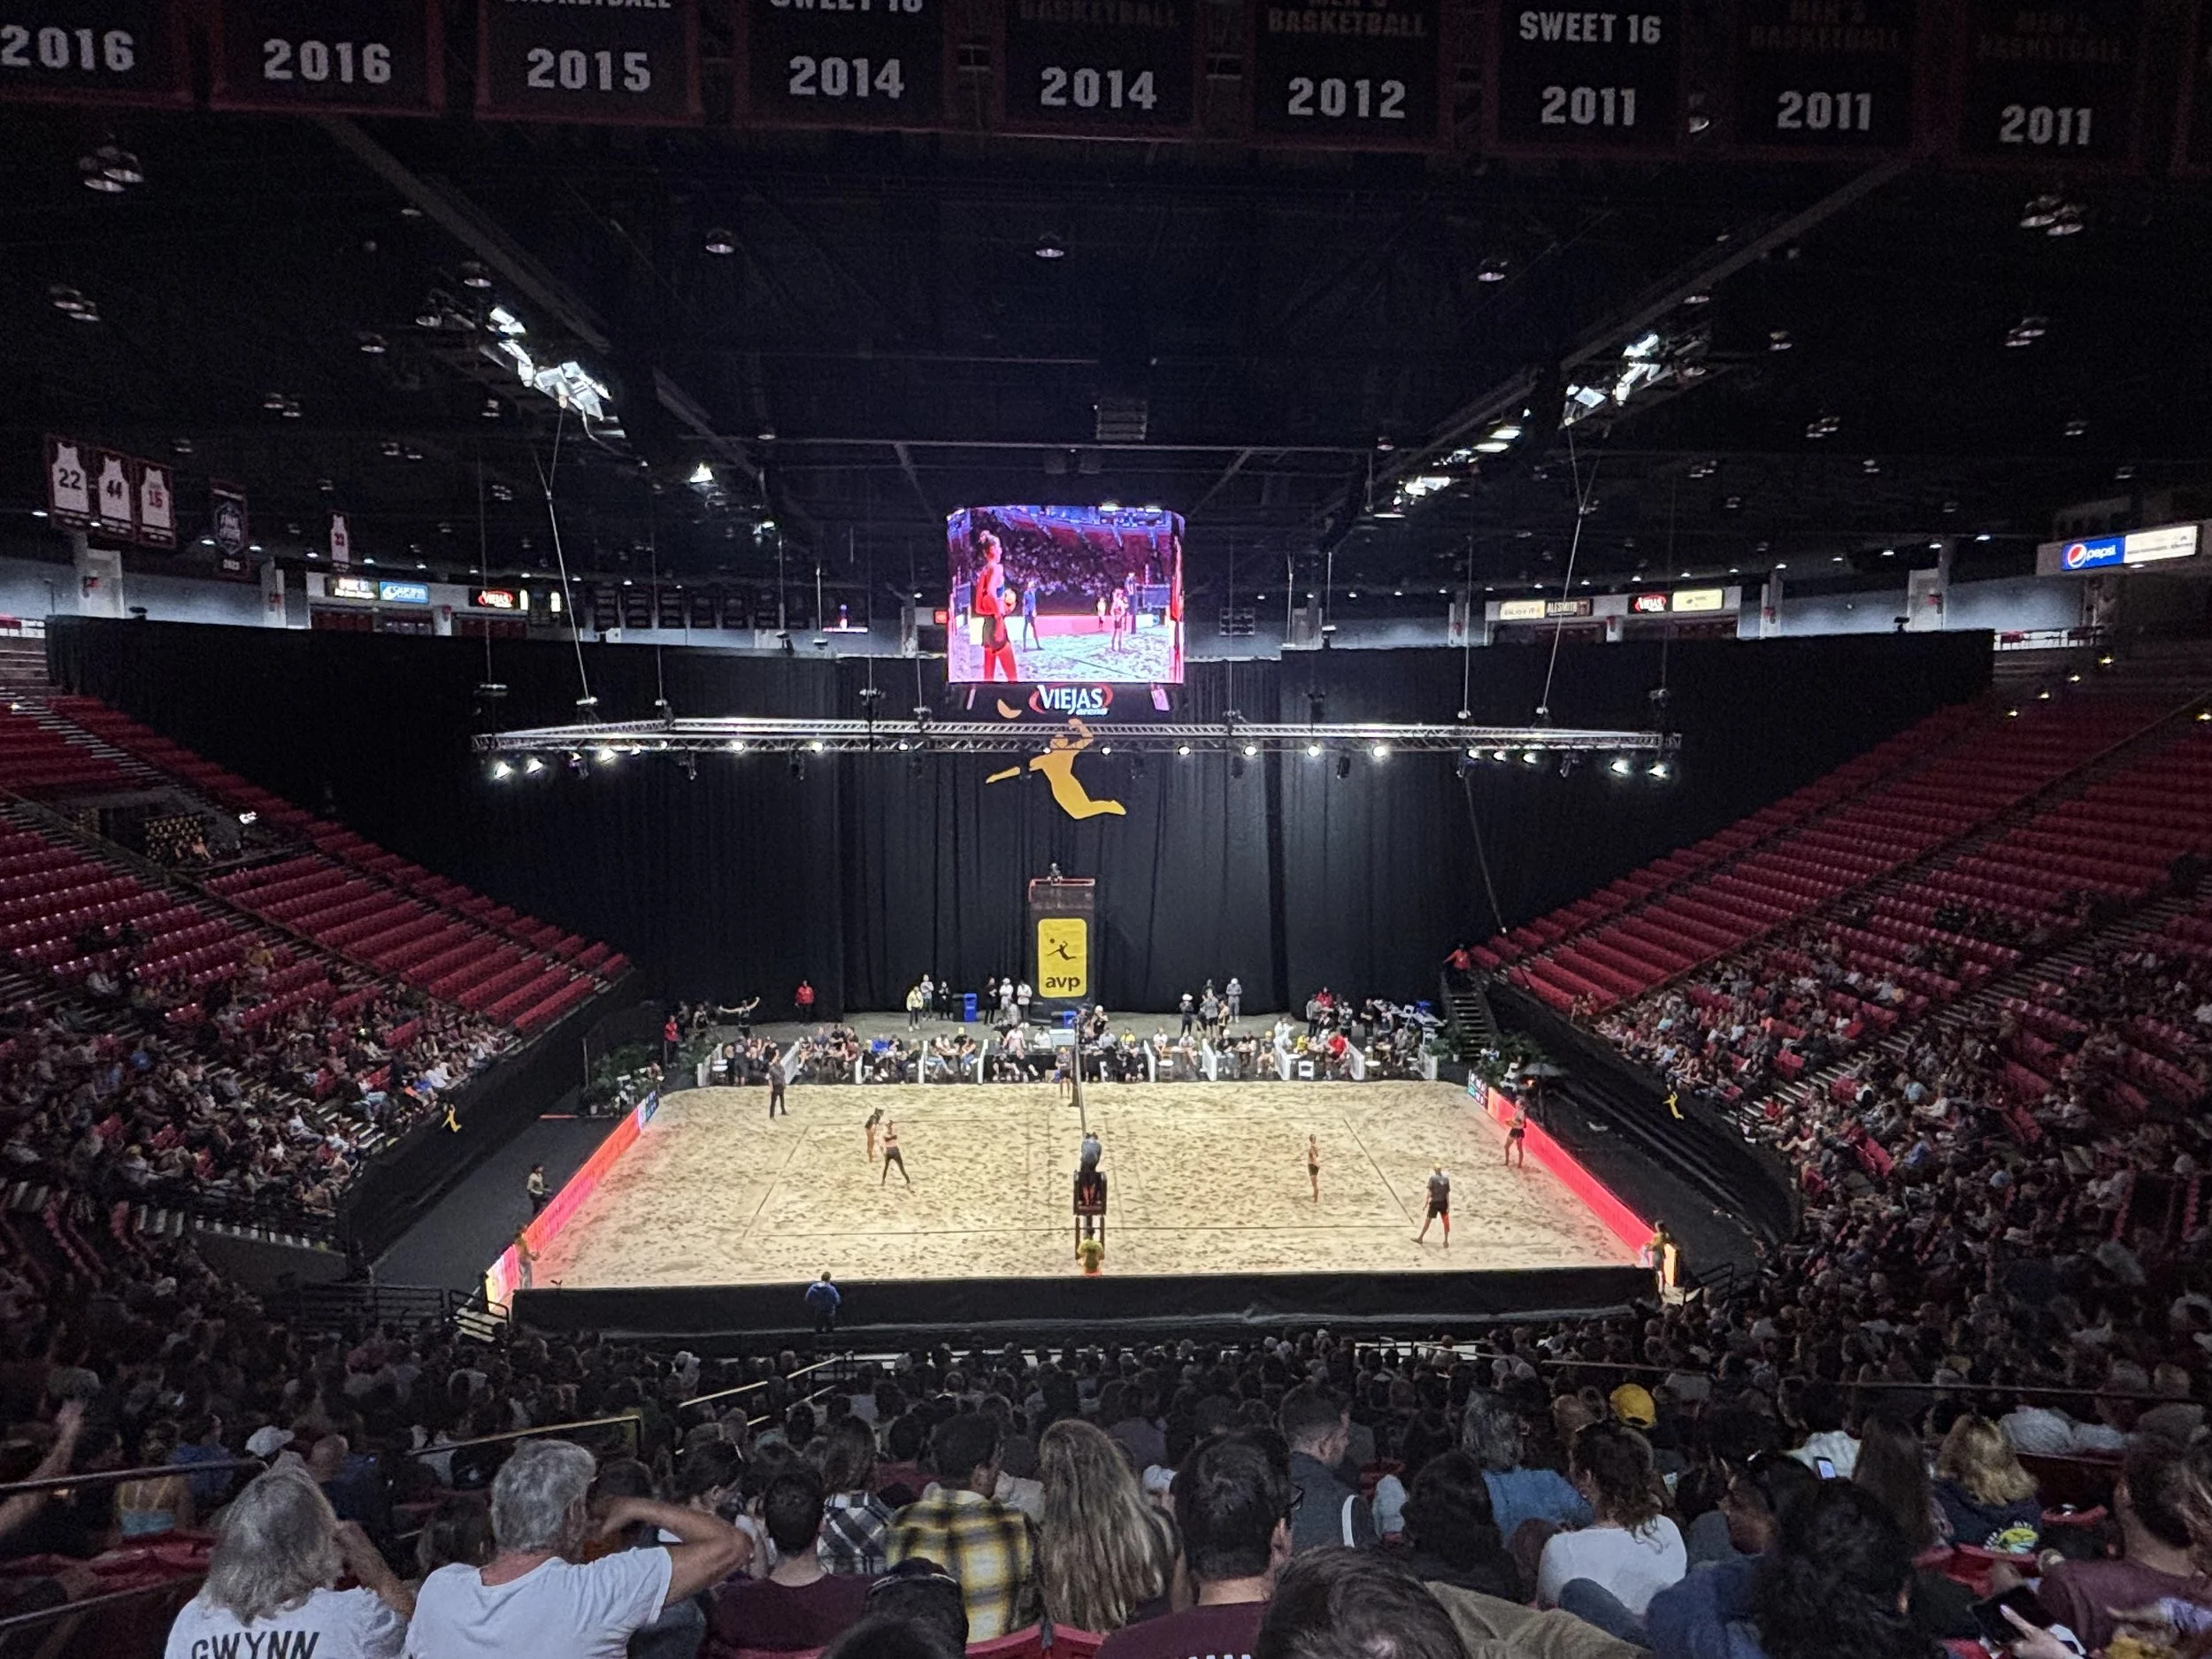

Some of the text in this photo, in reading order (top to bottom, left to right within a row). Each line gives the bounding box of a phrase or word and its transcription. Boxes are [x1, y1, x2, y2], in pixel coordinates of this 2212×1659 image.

[0, 24, 135, 72] 2016
[1518, 10, 1663, 45] SWEET 16
[264, 37, 392, 84] 2016
[526, 47, 651, 91] 2015
[788, 55, 905, 99] 2014
[1040, 65, 1158, 111] 2014
[1287, 76, 1406, 119] 2012
[1540, 85, 1636, 127] 2011
[1777, 90, 1873, 132] 2011
[1999, 103, 2093, 147] 2011
[58, 467, 81, 490] 22
[106, 480, 123, 500] 44
[2085, 544, 2117, 562] pepsi
[1037, 684, 1104, 715] VIEJAS
[1045, 976, 1081, 992] avp
[191, 1630, 320, 1659] GWYNN
